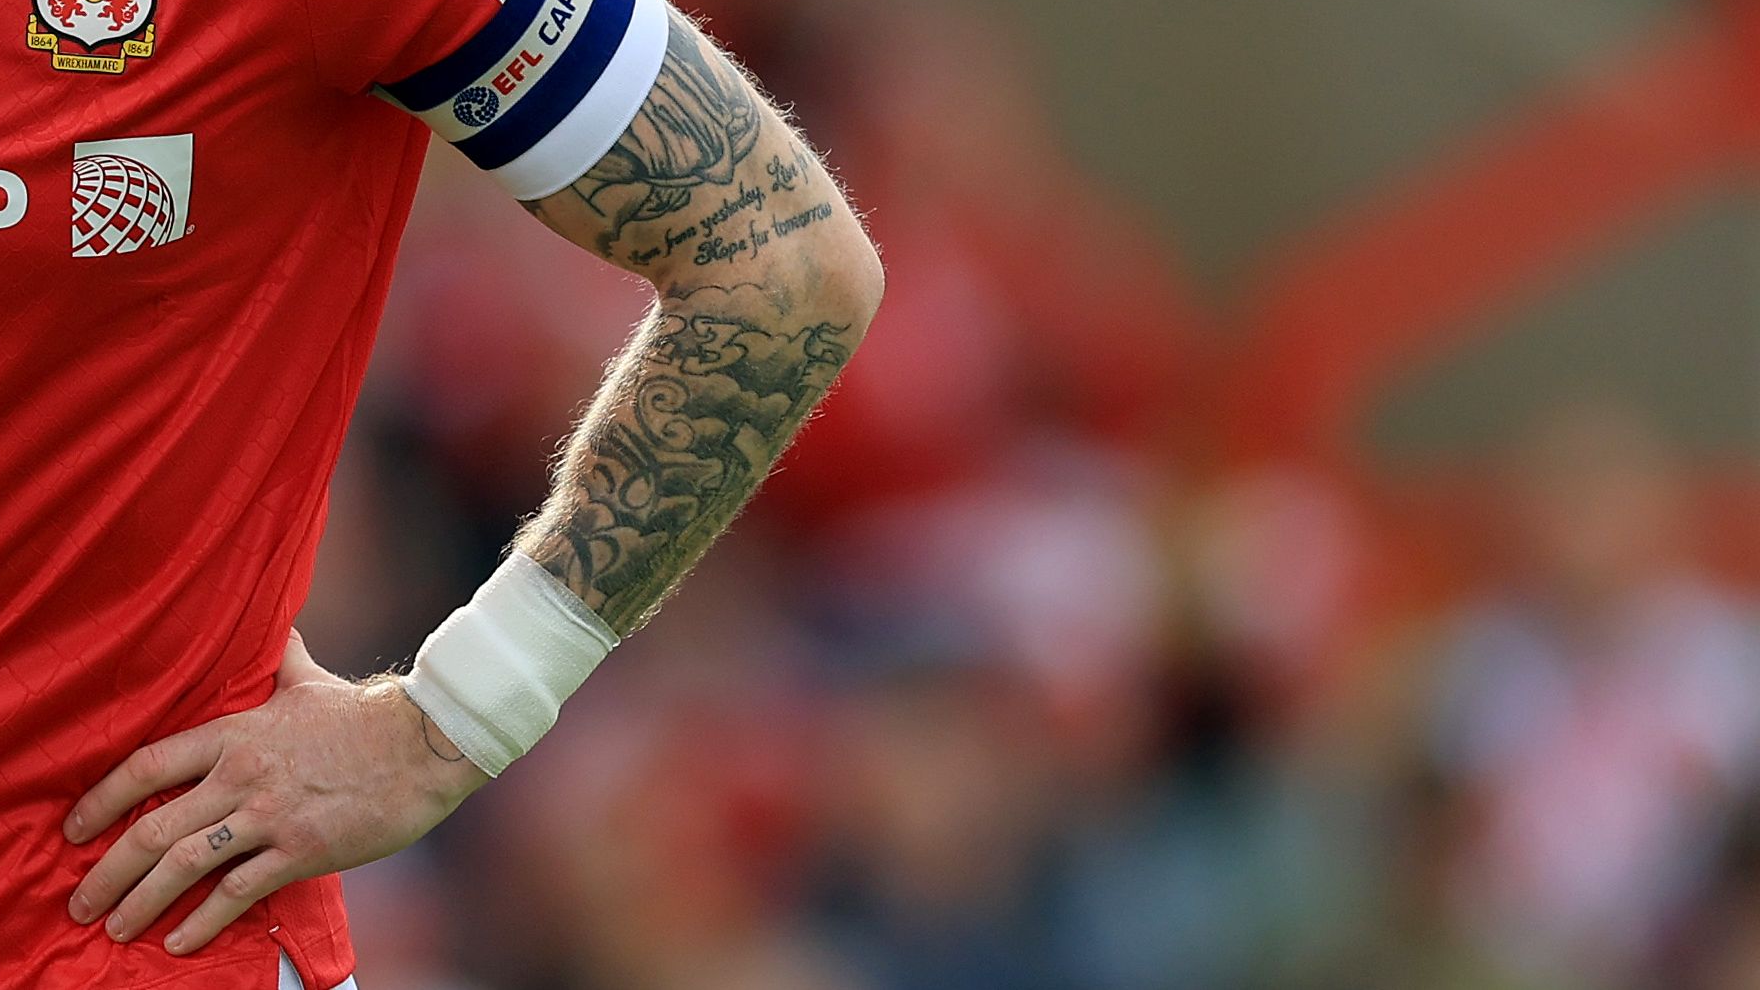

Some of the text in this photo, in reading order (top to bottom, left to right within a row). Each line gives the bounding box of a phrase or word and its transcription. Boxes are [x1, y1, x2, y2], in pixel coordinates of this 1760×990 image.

[30, 35, 53, 48] 1864
[127, 42, 149, 54] 1864
[56, 56, 119, 72] WREXHAM AFC
[491, 50, 544, 95] EFL
[694, 202, 832, 265] Hope for tomorrow
[206, 824, 234, 851] E
